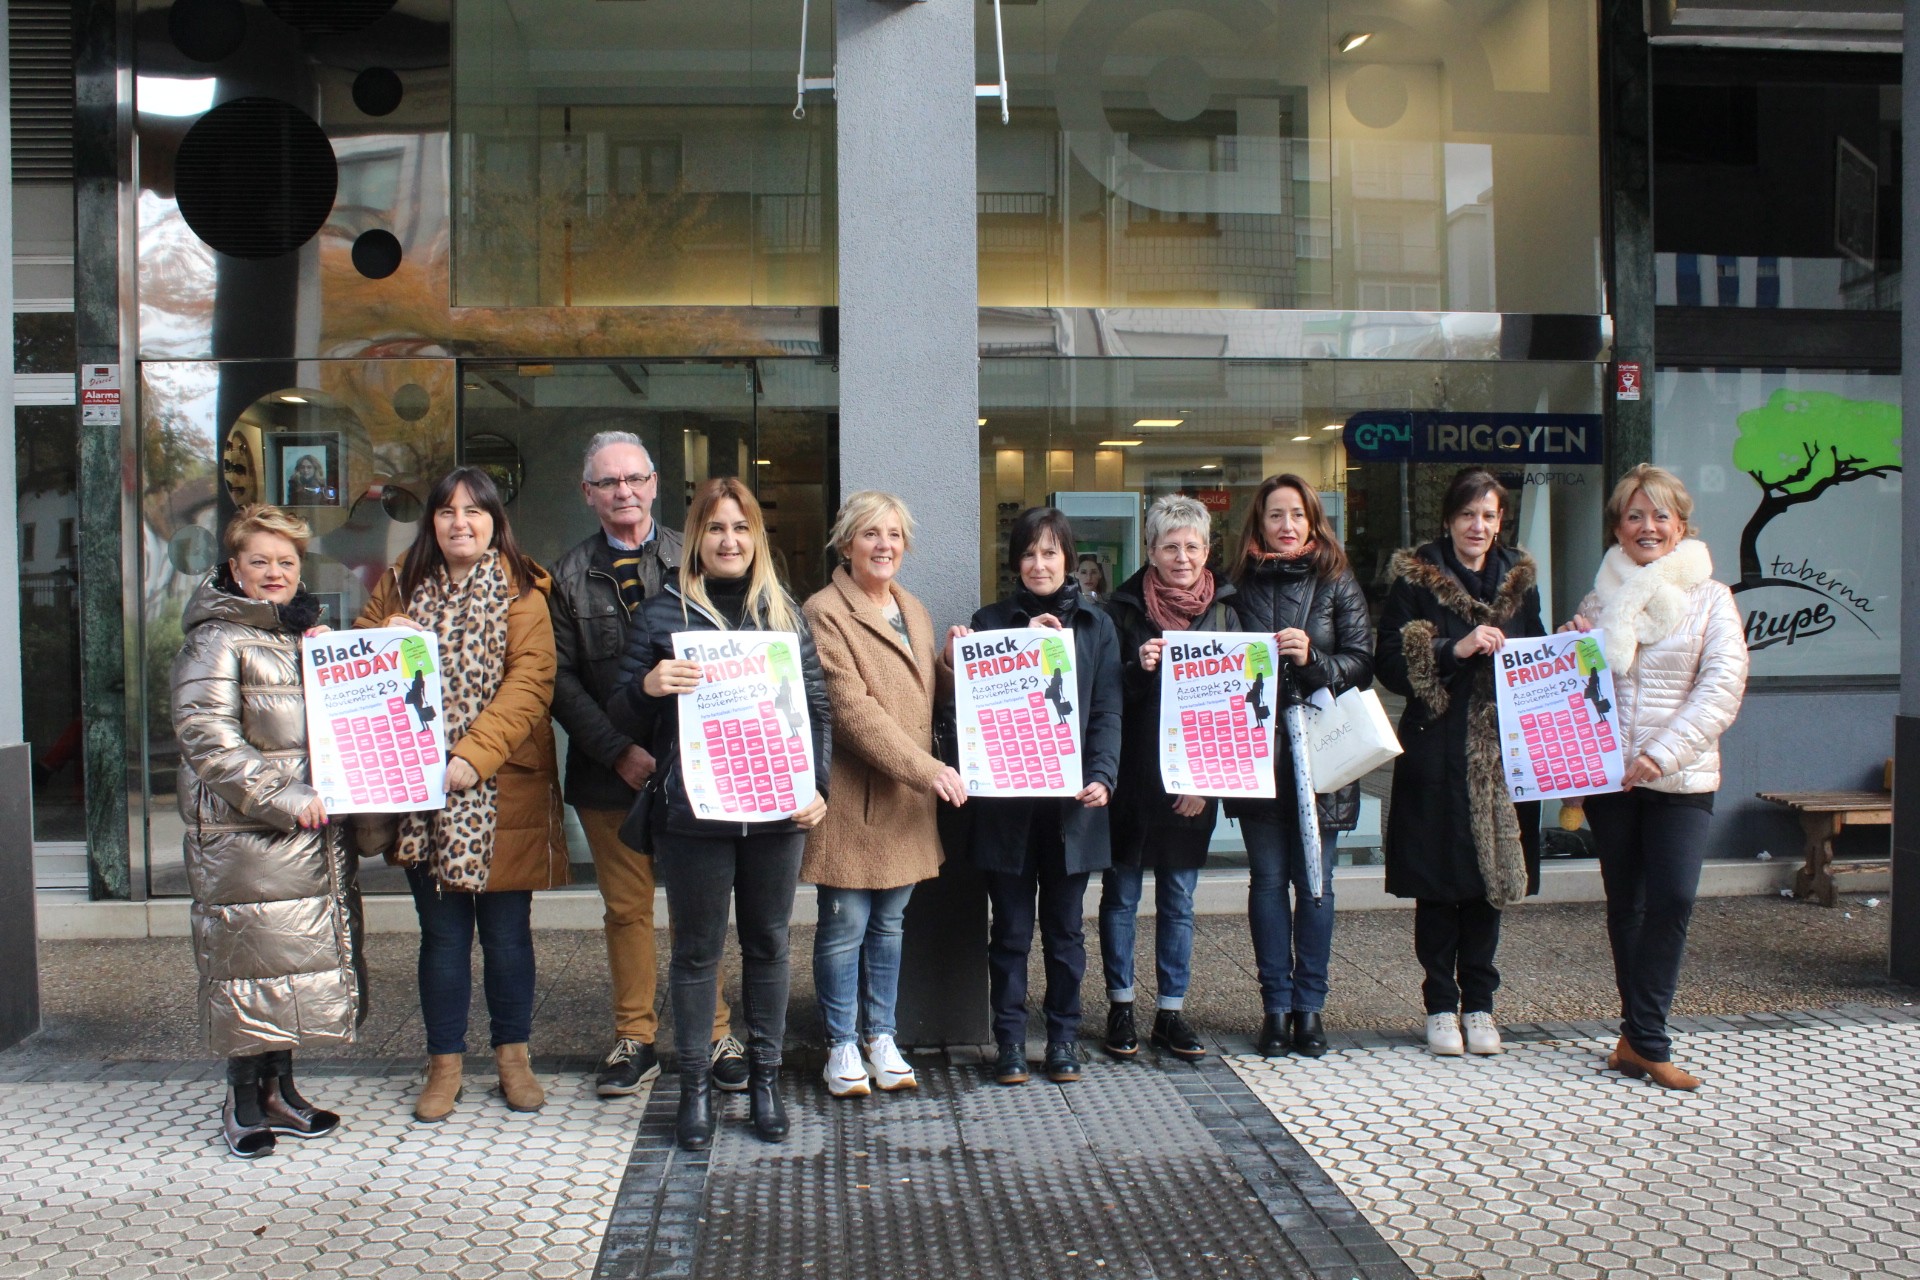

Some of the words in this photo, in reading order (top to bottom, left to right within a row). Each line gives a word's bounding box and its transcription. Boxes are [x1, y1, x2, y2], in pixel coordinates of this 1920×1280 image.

[85, 390, 119, 399] Alarma
[1427, 424, 1587, 454] IRIGOYEN
[1771, 555, 1874, 612] taberna
[312, 638, 375, 667] Black
[684, 639, 745, 664] Black
[961, 636, 1019, 662] Black
[1170, 639, 1225, 662] Black
[1501, 643, 1558, 670] Black
[317, 651, 399, 687] FRIDAY
[699, 655, 766, 684] RIDAY
[965, 649, 1040, 680] FRIDAY
[1173, 653, 1245, 681] FRIDAY
[1505, 651, 1576, 688] FRIDAY
[324, 685, 374, 701] Azaroak
[377, 680, 398, 695] 29
[696, 687, 746, 703] Azaroak
[750, 683, 768, 699] 29
[971, 679, 1017, 694] Azaroak
[1019, 676, 1039, 690] 29
[972, 687, 1020, 701] Noviembre
[1176, 681, 1221, 695] Azaroak
[1223, 679, 1241, 693] 29
[1177, 689, 1222, 702] Noviembre
[1513, 683, 1557, 700] Azaroak
[1558, 678, 1578, 693] 29
[325, 693, 377, 708] Noviembre
[697, 695, 749, 710] Noviembre
[1514, 691, 1559, 707] Noviembre
[1313, 721, 1352, 752] LAROME
